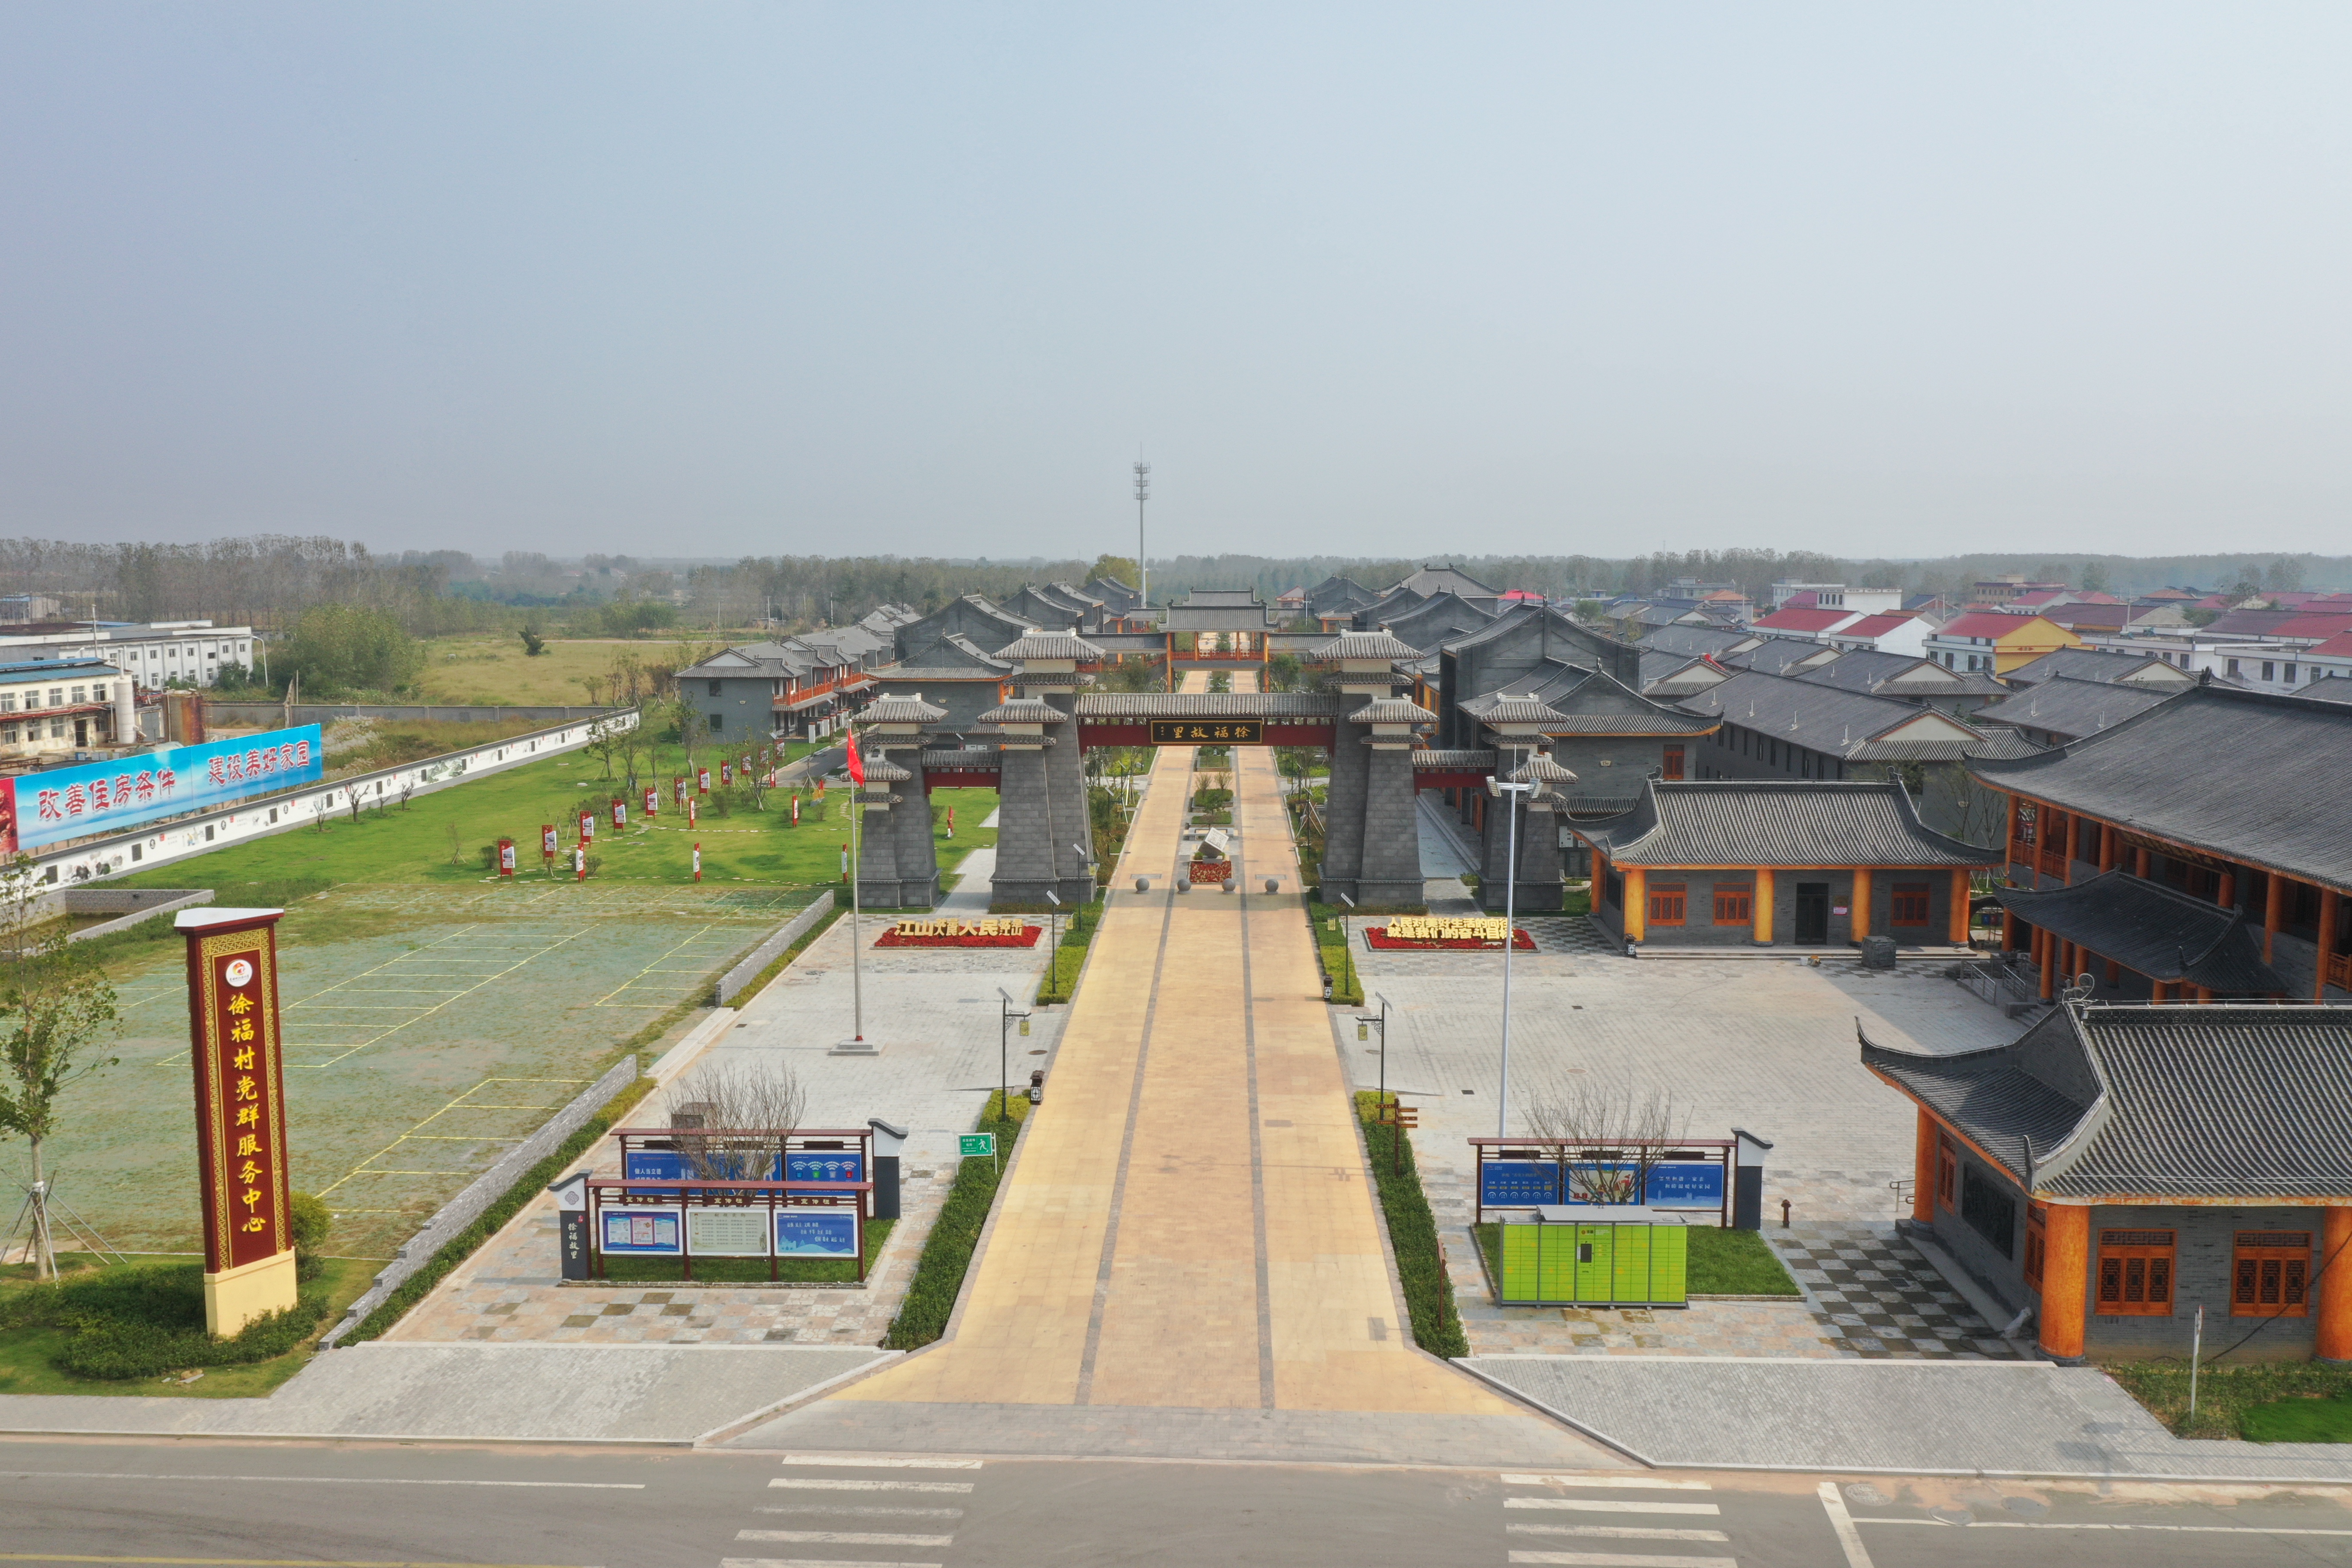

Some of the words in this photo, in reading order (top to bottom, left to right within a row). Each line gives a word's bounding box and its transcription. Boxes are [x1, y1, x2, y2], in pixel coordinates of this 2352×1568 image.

[1173, 726, 1251, 738] 徐福故里
[37, 767, 176, 820] 改善住房条件
[208, 740, 310, 786] 建设美好家园
[894, 919, 934, 936] 江山
[226, 993, 266, 1233] 徐福村党群服务中心
[568, 1223, 580, 1259] 徐福故里
